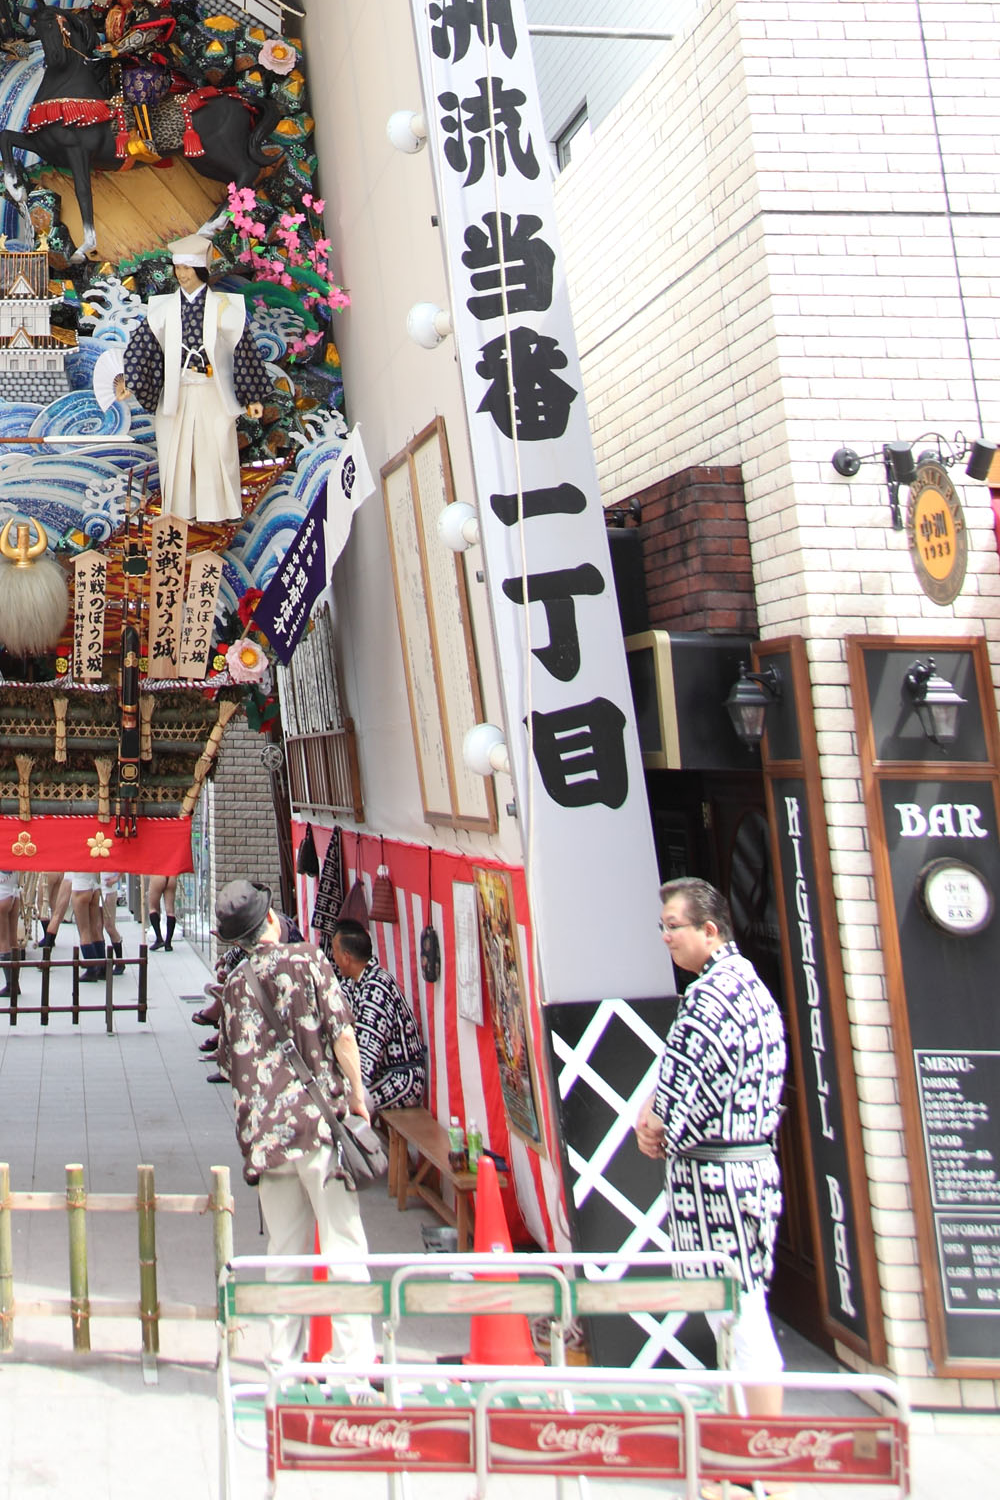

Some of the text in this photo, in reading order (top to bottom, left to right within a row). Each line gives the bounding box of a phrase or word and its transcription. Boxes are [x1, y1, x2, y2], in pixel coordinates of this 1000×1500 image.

[920, 510, 948, 542] 中洲
[153, 525, 184, 666] 決戦のぼうの城
[87, 562, 106, 672] 決戦のぼうの城
[189, 563, 220, 664] 決戦のぼうの城
[894, 803, 988, 838] BAR
[948, 909, 973, 919] BAR
[784, 796, 856, 1317] HIGHBALL BAR
[922, 1077, 961, 1090] DRINK
[929, 1134, 963, 1148] FOOD
[330, 1418, 412, 1450] Coca-Cola
[536, 1421, 620, 1453] Coca-Cola
[748, 1429, 834, 1458] Coca-Cola
